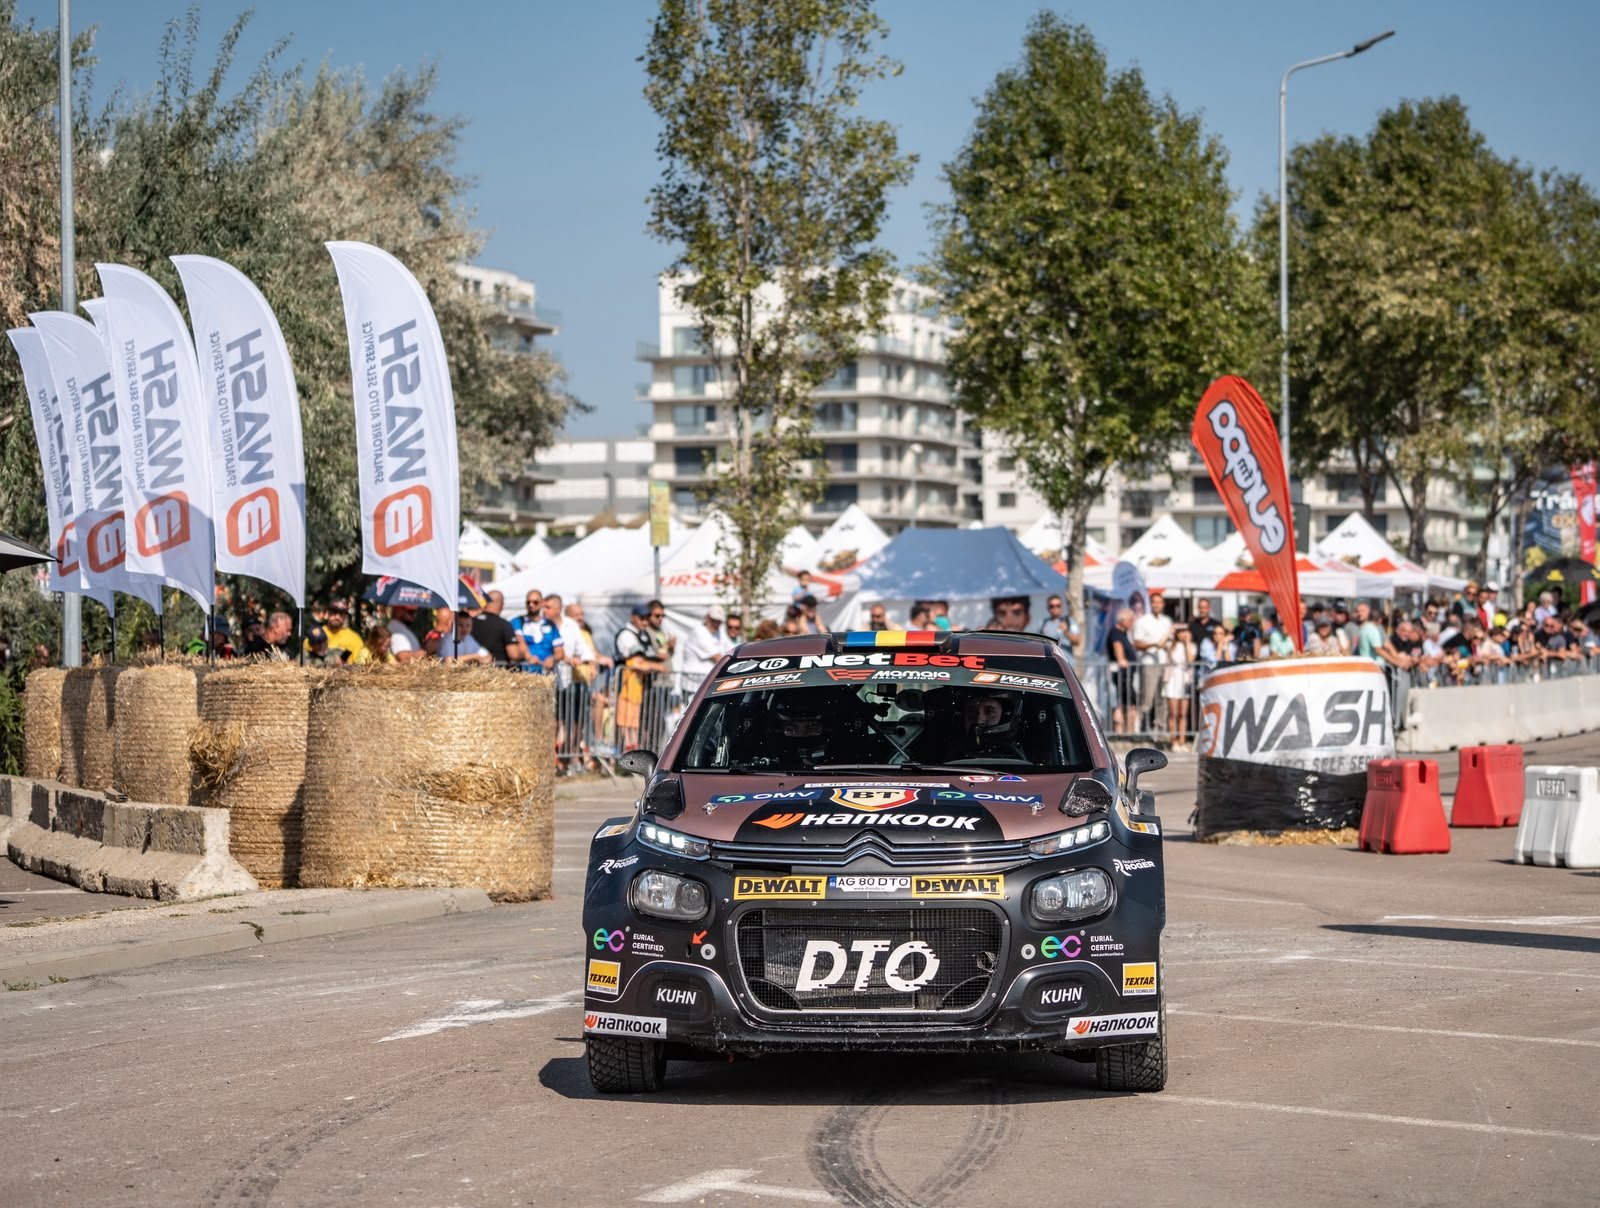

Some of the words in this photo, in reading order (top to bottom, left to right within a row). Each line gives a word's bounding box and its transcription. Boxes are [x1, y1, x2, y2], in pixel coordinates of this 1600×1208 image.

[765, 660, 783, 668] 16
[799, 653, 985, 669] NetBet
[743, 673, 802, 685] WASH
[1000, 675, 1059, 688] WASH
[1222, 690, 1387, 758] WASH
[752, 791, 816, 800] OMV
[852, 791, 900, 799] BT
[972, 793, 1036, 802] OMV
[1124, 861, 1155, 870] ROGER
[838, 877, 856, 886] AG
[859, 877, 875, 886] 80
[878, 877, 909, 886] DTO
[633, 933, 655, 942] EURIAL
[632, 942, 664, 952] CERTIFIED
[795, 940, 941, 992] DTO
[589, 973, 617, 985] TEXTAR
[1125, 977, 1154, 986] TEXTAR
[656, 987, 697, 1005] KUHN
[1041, 986, 1083, 1004] KUHN
